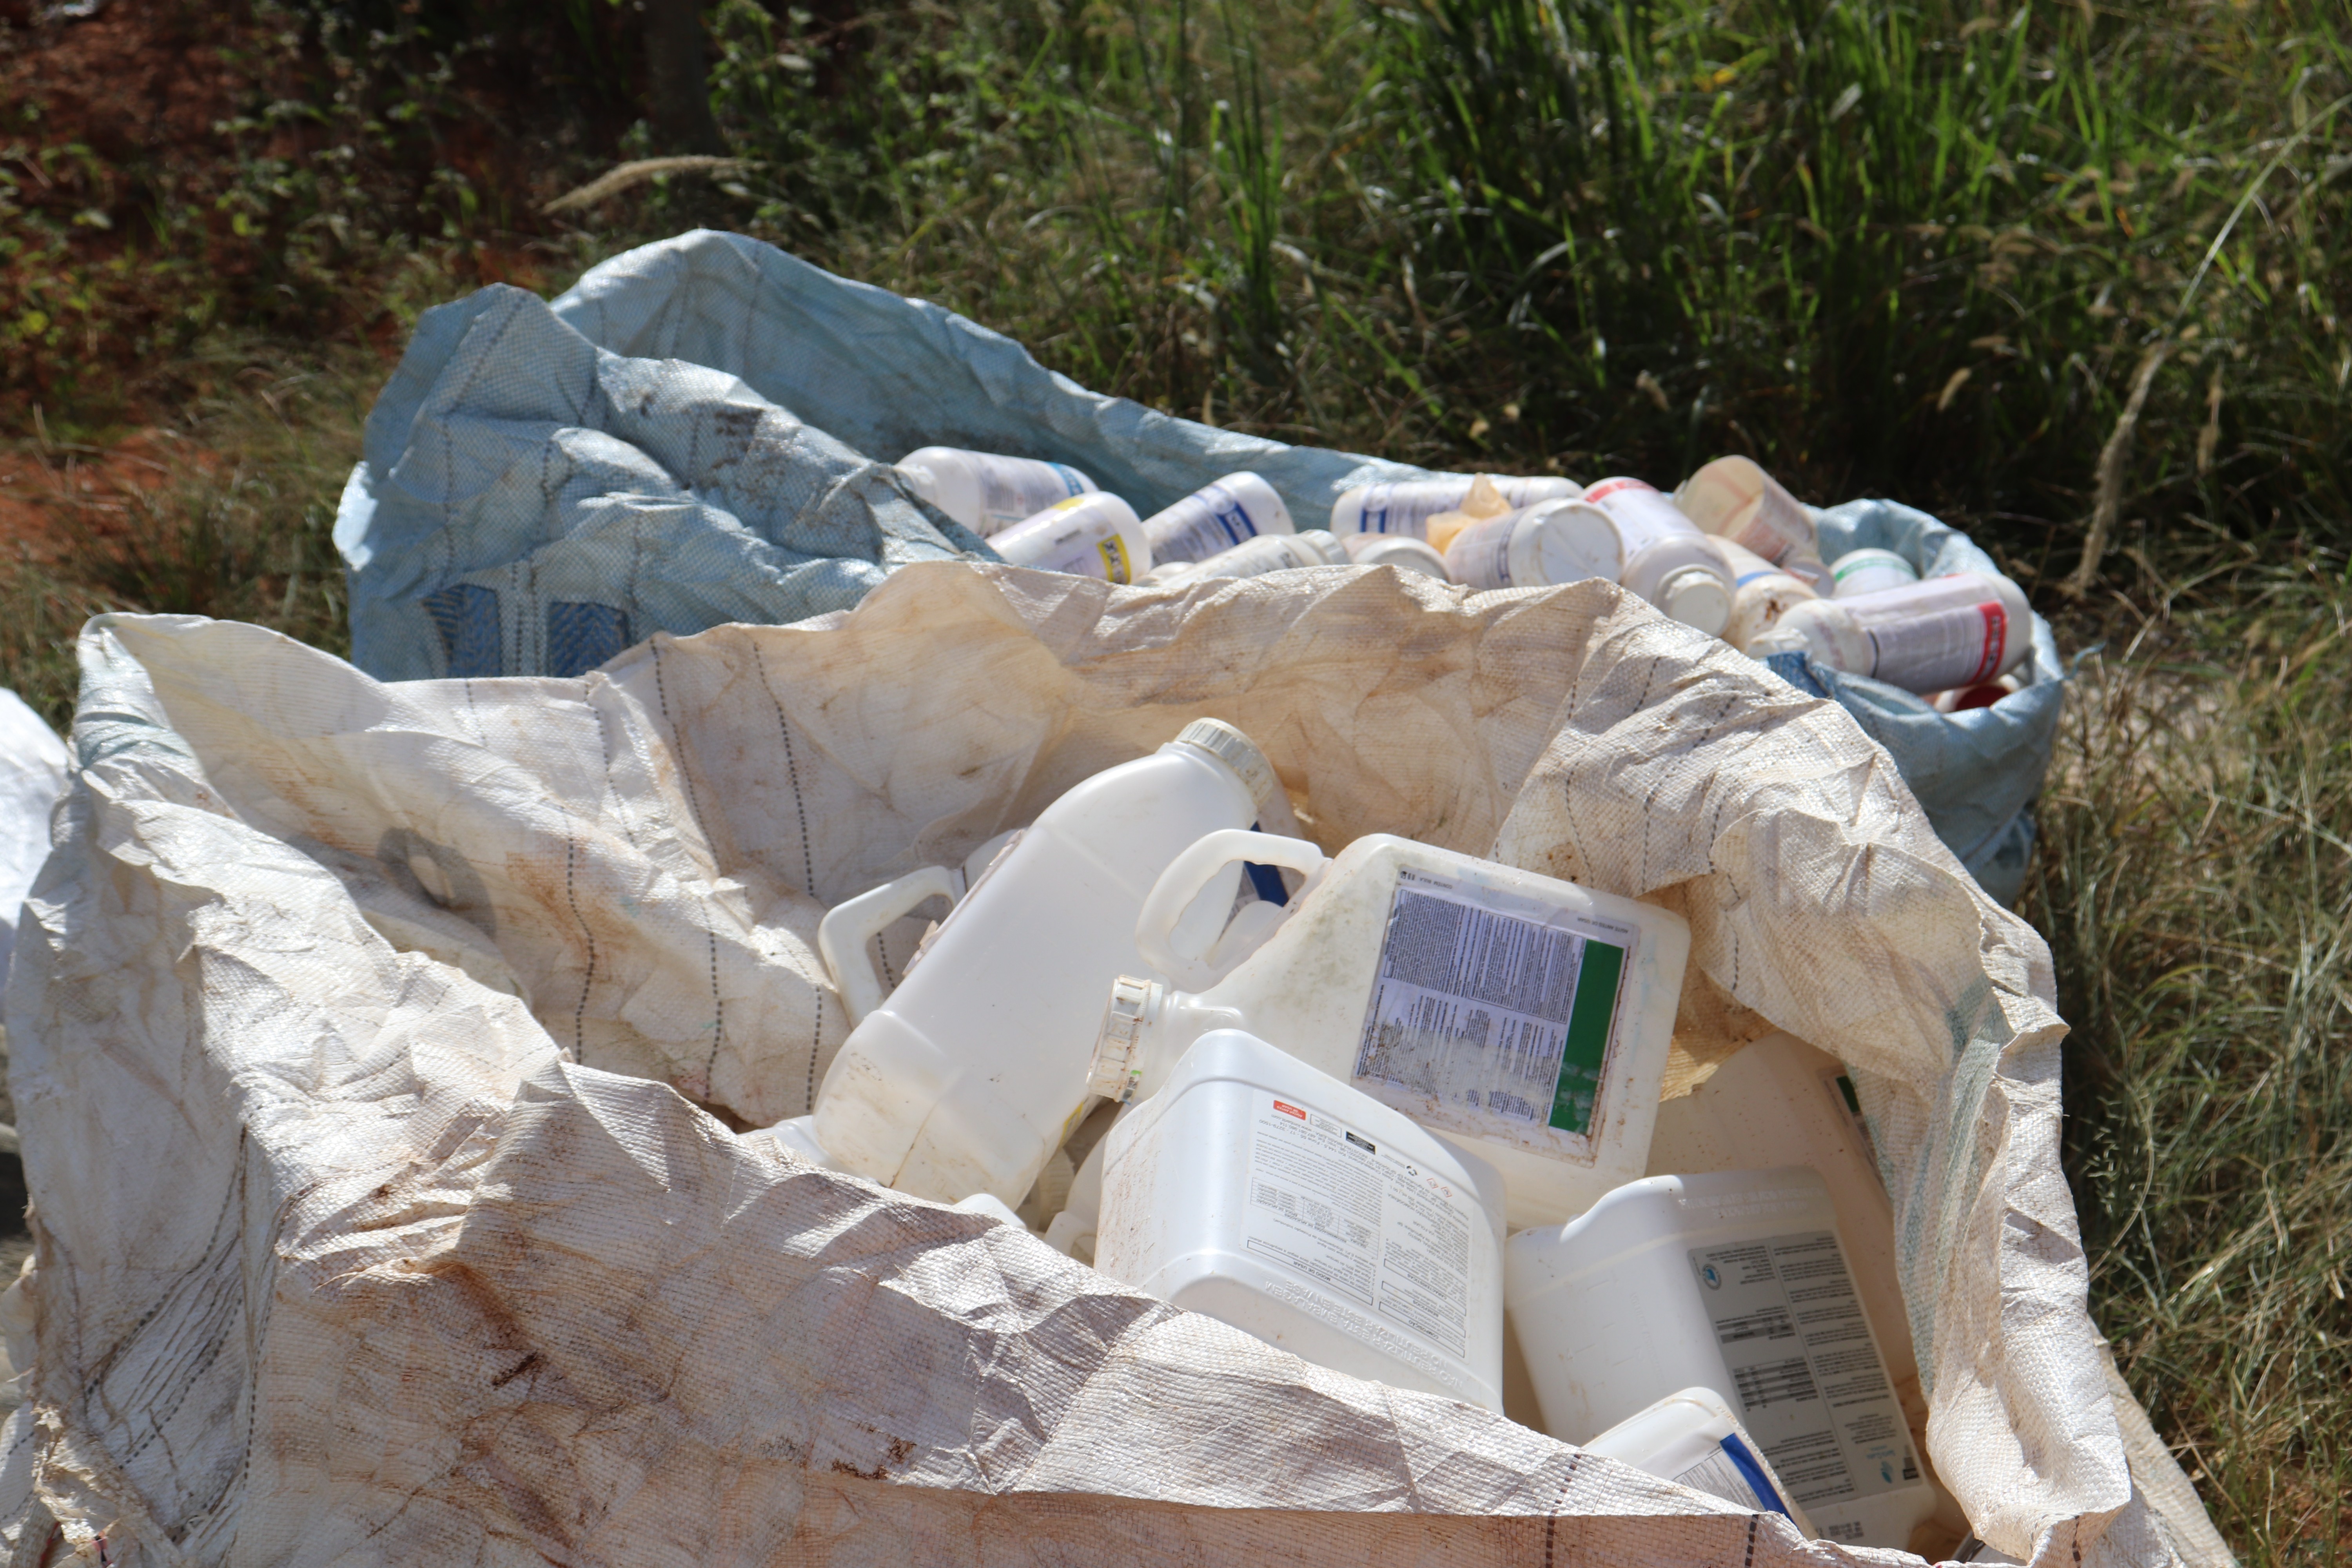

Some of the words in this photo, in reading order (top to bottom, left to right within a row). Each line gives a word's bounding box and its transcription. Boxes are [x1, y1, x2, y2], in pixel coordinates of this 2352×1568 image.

[1307, 1136, 1320, 1145] Fone
[1293, 1260, 1307, 1270] USAR
[1316, 1271, 1330, 1281] MODO
[1407, 1273, 1447, 1300] CARACTERÍSTICAS
[1264, 1279, 1338, 1326] EMBALAGEM
[1333, 1301, 1361, 1326] ESTE
[1412, 1299, 1439, 1318] BENEFÍCIOS
[1342, 1318, 1369, 1342] ESTA
[1365, 1318, 1428, 1359] REUTILIZAR
[1408, 1319, 1439, 1339] COMPOSIÇÃO
[1372, 1334, 1436, 1376] REUTILIZAR
